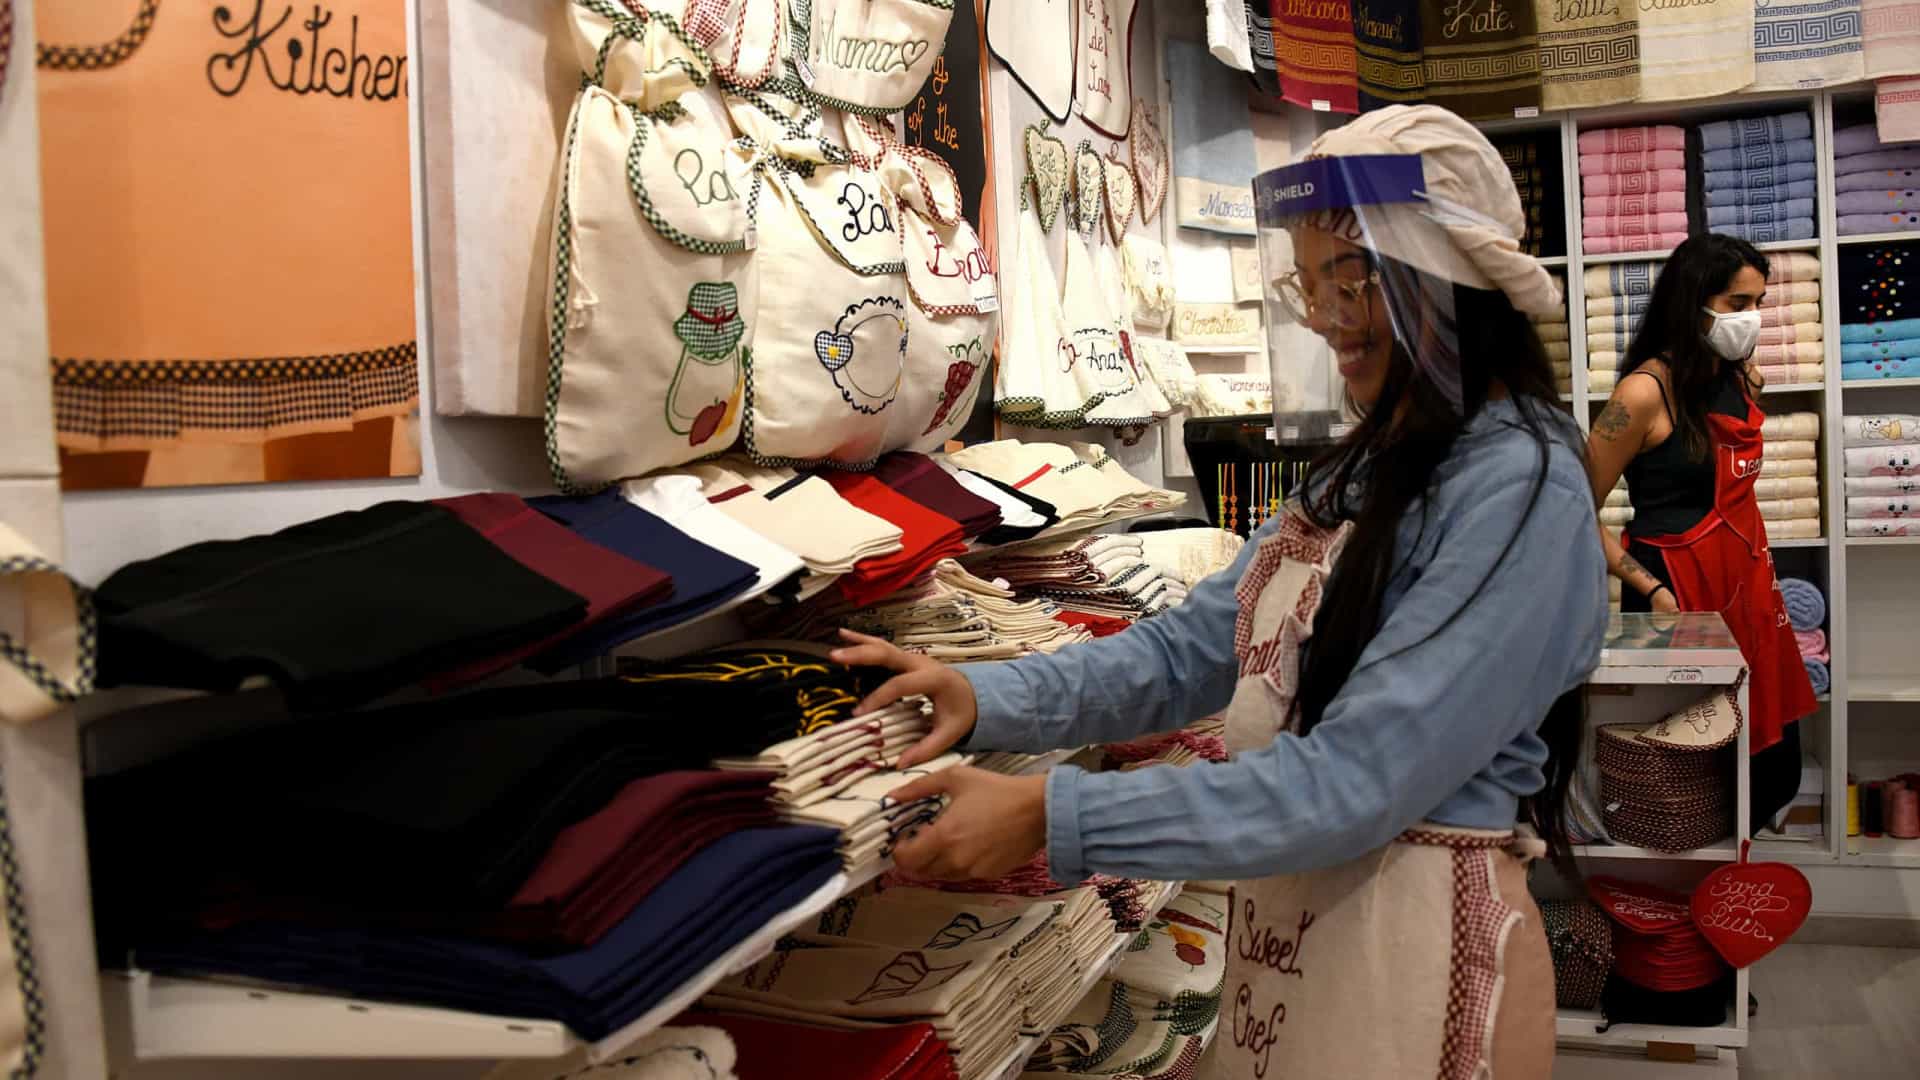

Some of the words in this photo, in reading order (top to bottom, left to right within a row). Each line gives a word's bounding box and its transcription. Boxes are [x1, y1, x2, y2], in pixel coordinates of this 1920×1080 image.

[1273, 181, 1315, 202] SHIELD
[1710, 872, 1775, 897] Sara
[1238, 898, 1316, 980] Sweet
[1233, 983, 1287, 1079] Chef
